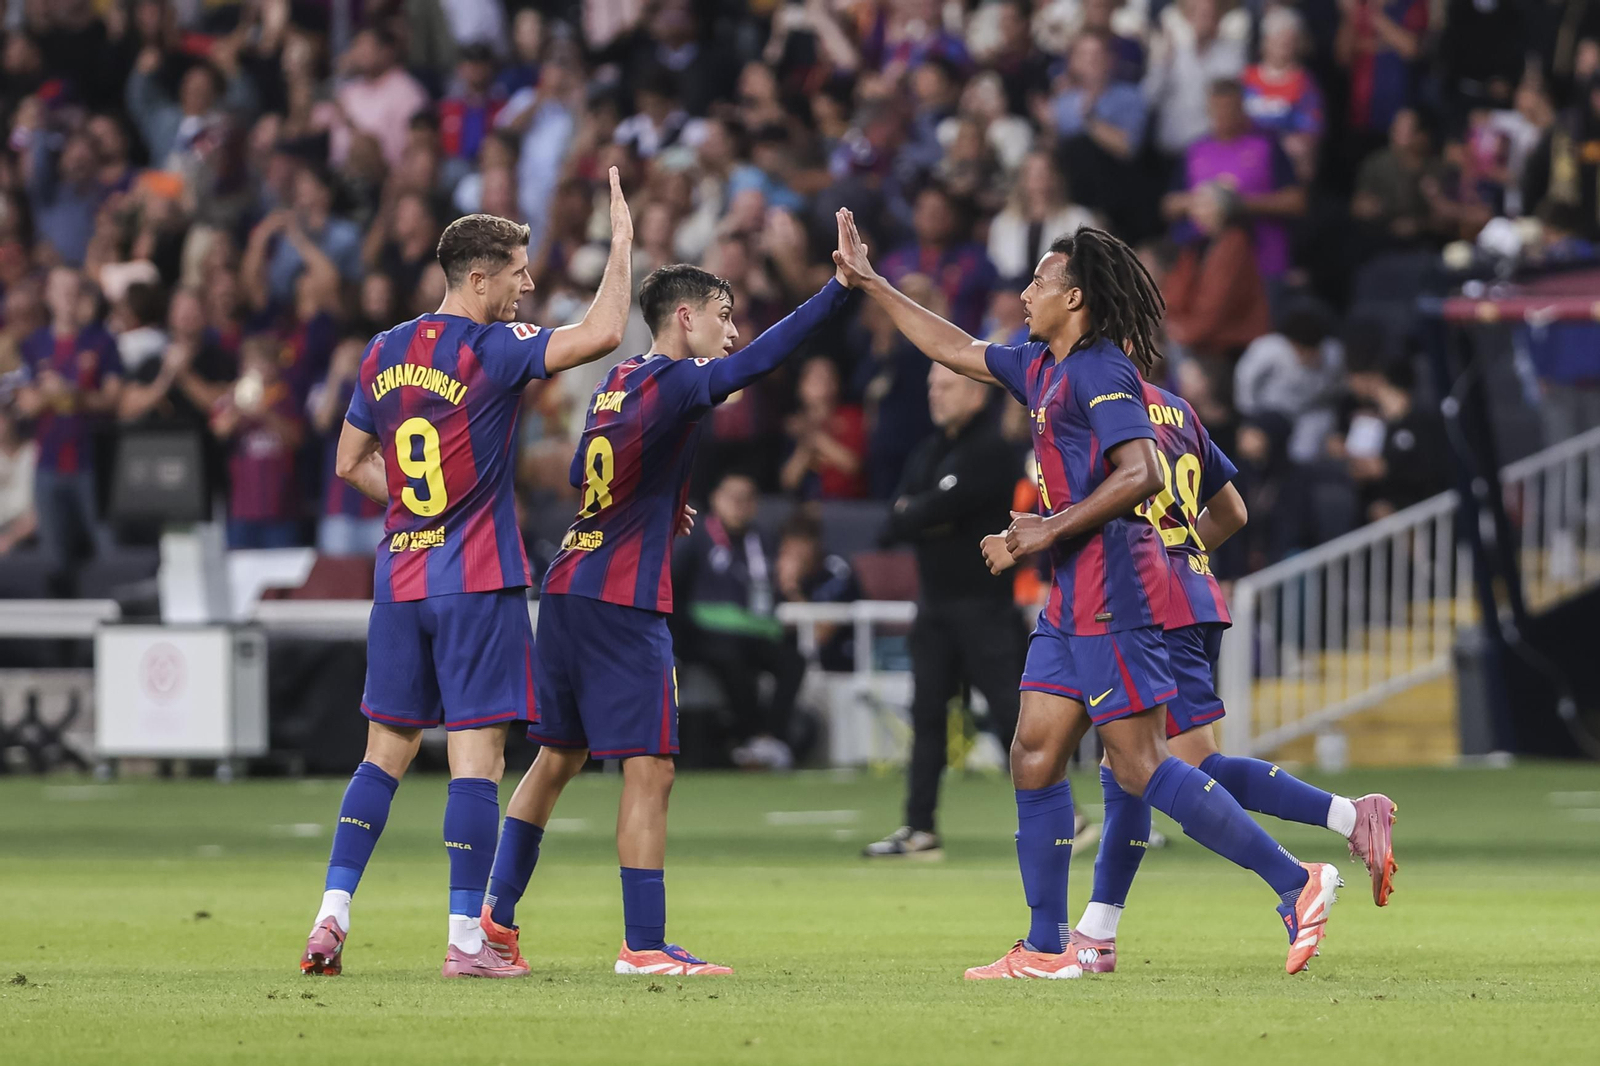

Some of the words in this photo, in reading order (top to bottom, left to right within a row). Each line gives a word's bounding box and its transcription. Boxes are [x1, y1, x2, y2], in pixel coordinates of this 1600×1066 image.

[371, 363, 468, 406] LEWANDOWSKI
[1148, 403, 1184, 429] ONY
[395, 416, 448, 517] 9
[578, 435, 615, 519] 8
[1129, 839, 1150, 849] BAR
